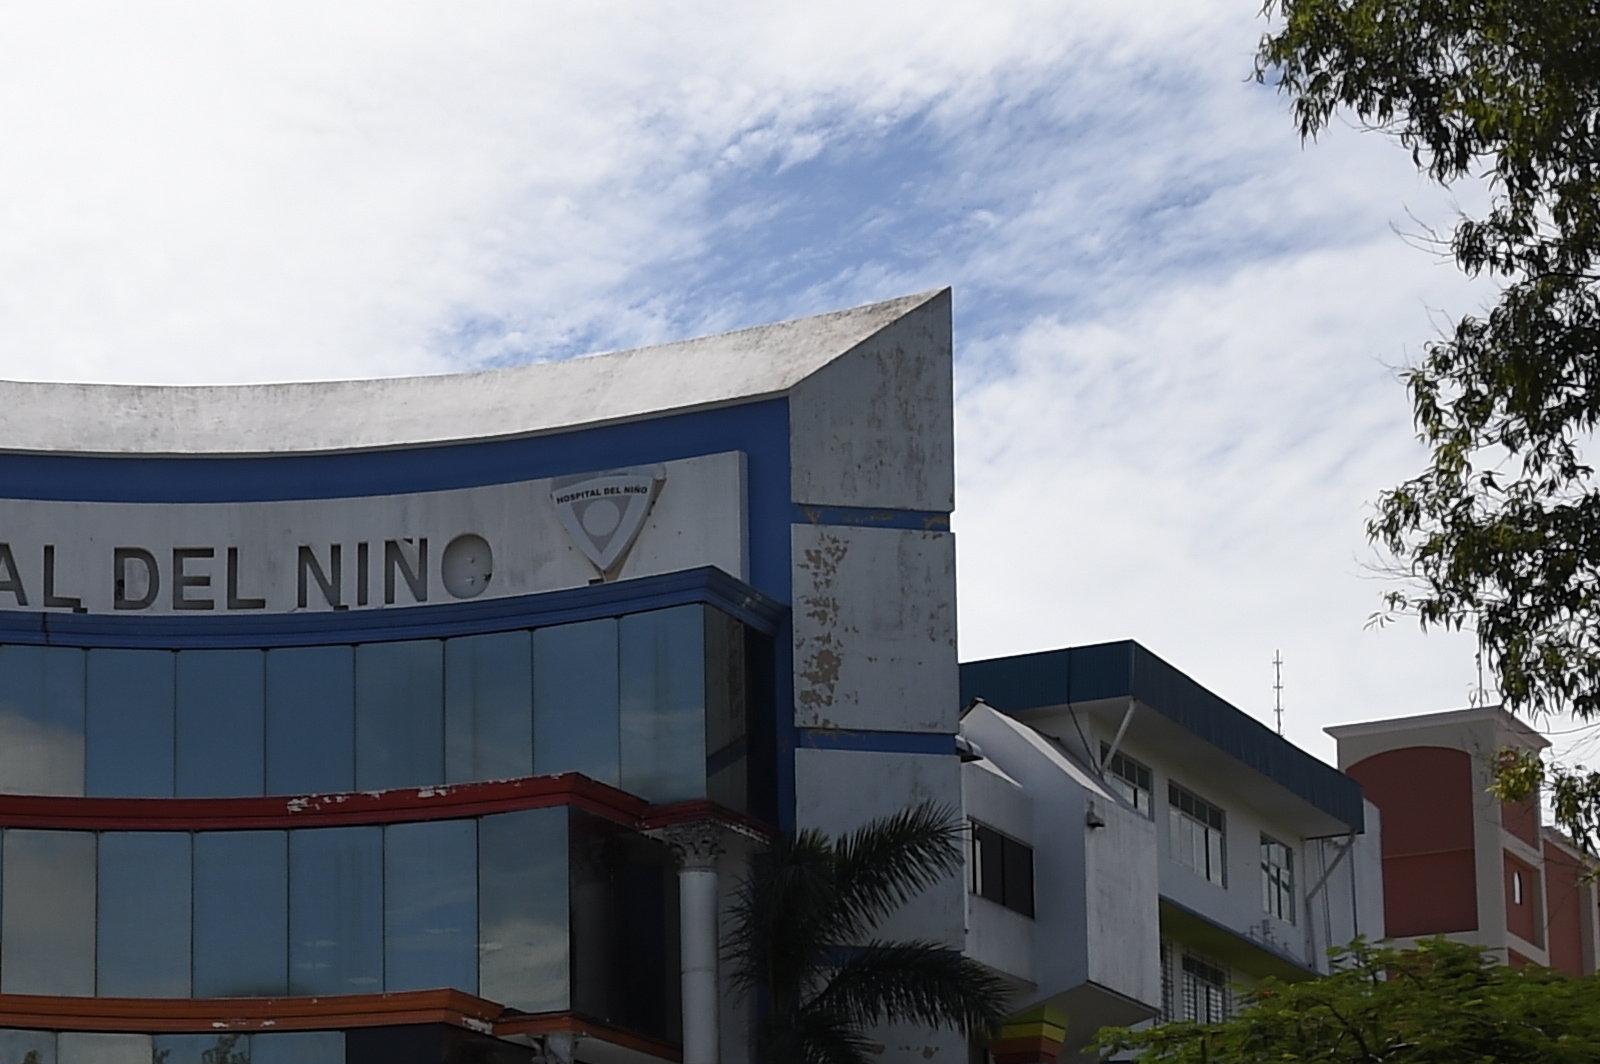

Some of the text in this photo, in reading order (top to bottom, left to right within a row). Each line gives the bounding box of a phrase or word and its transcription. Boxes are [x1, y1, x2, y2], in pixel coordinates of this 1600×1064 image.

[556, 483, 648, 504] HOSPITAL DEL NIÑO
[113, 547, 266, 610] DEL
